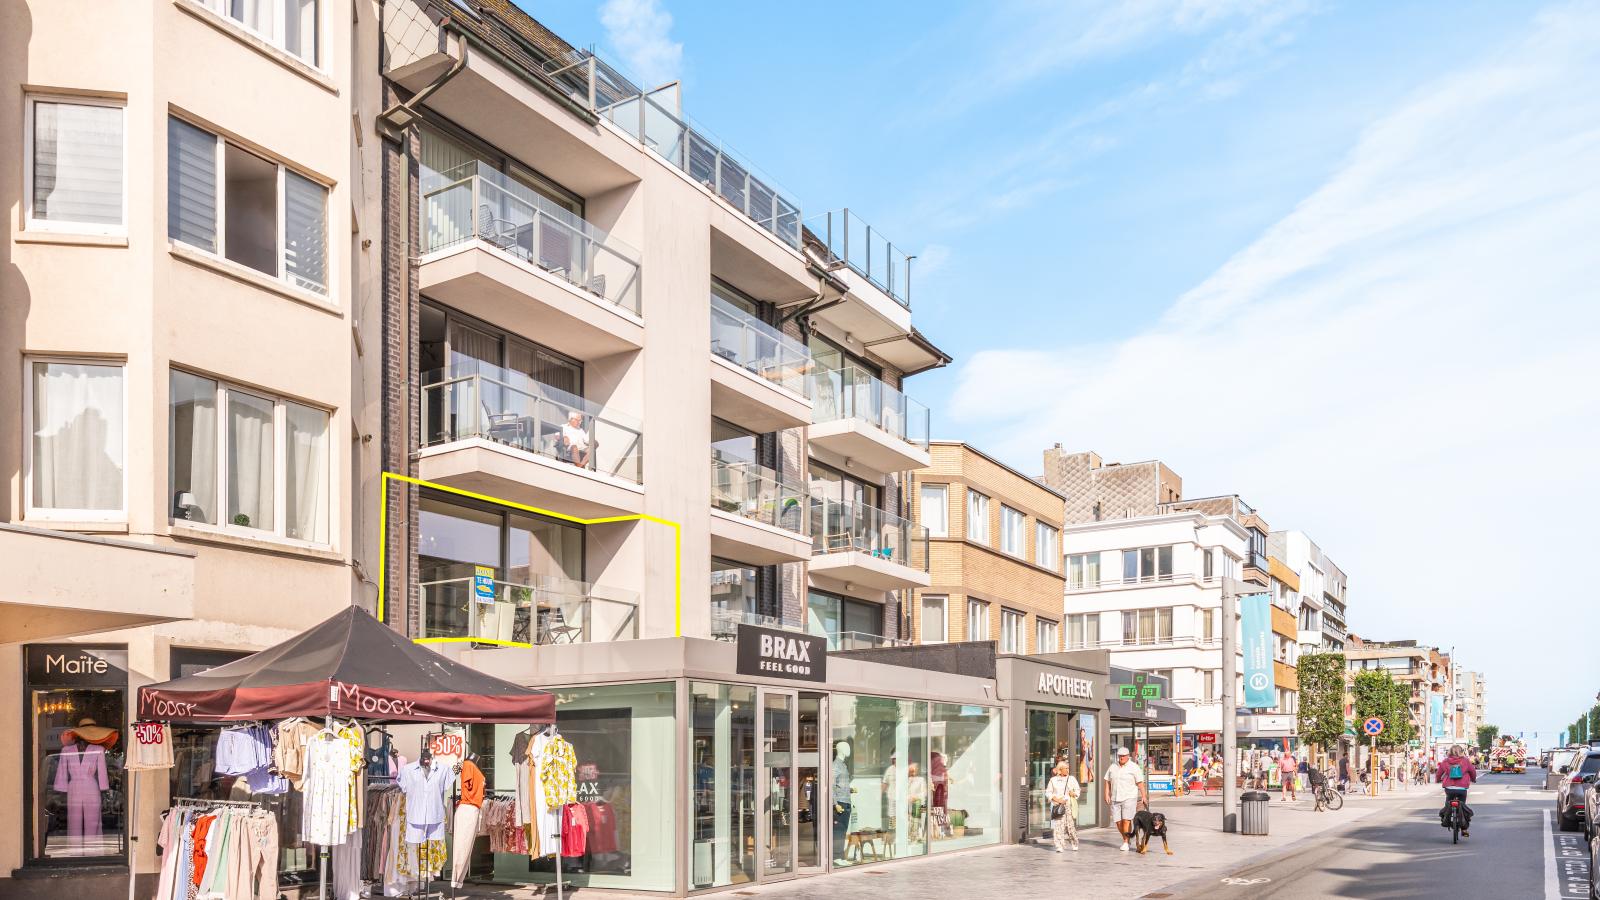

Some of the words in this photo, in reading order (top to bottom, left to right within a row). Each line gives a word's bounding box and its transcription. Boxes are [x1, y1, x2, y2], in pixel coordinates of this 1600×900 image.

[760, 634, 811, 663] BRAX
[760, 661, 784, 672] FEEL
[786, 664, 811, 675] GOOD
[1038, 672, 1093, 699] APOTHEEK
[137, 725, 161, 743] -50%
[431, 736, 460, 754] -50%
[577, 782, 599, 795] AX
